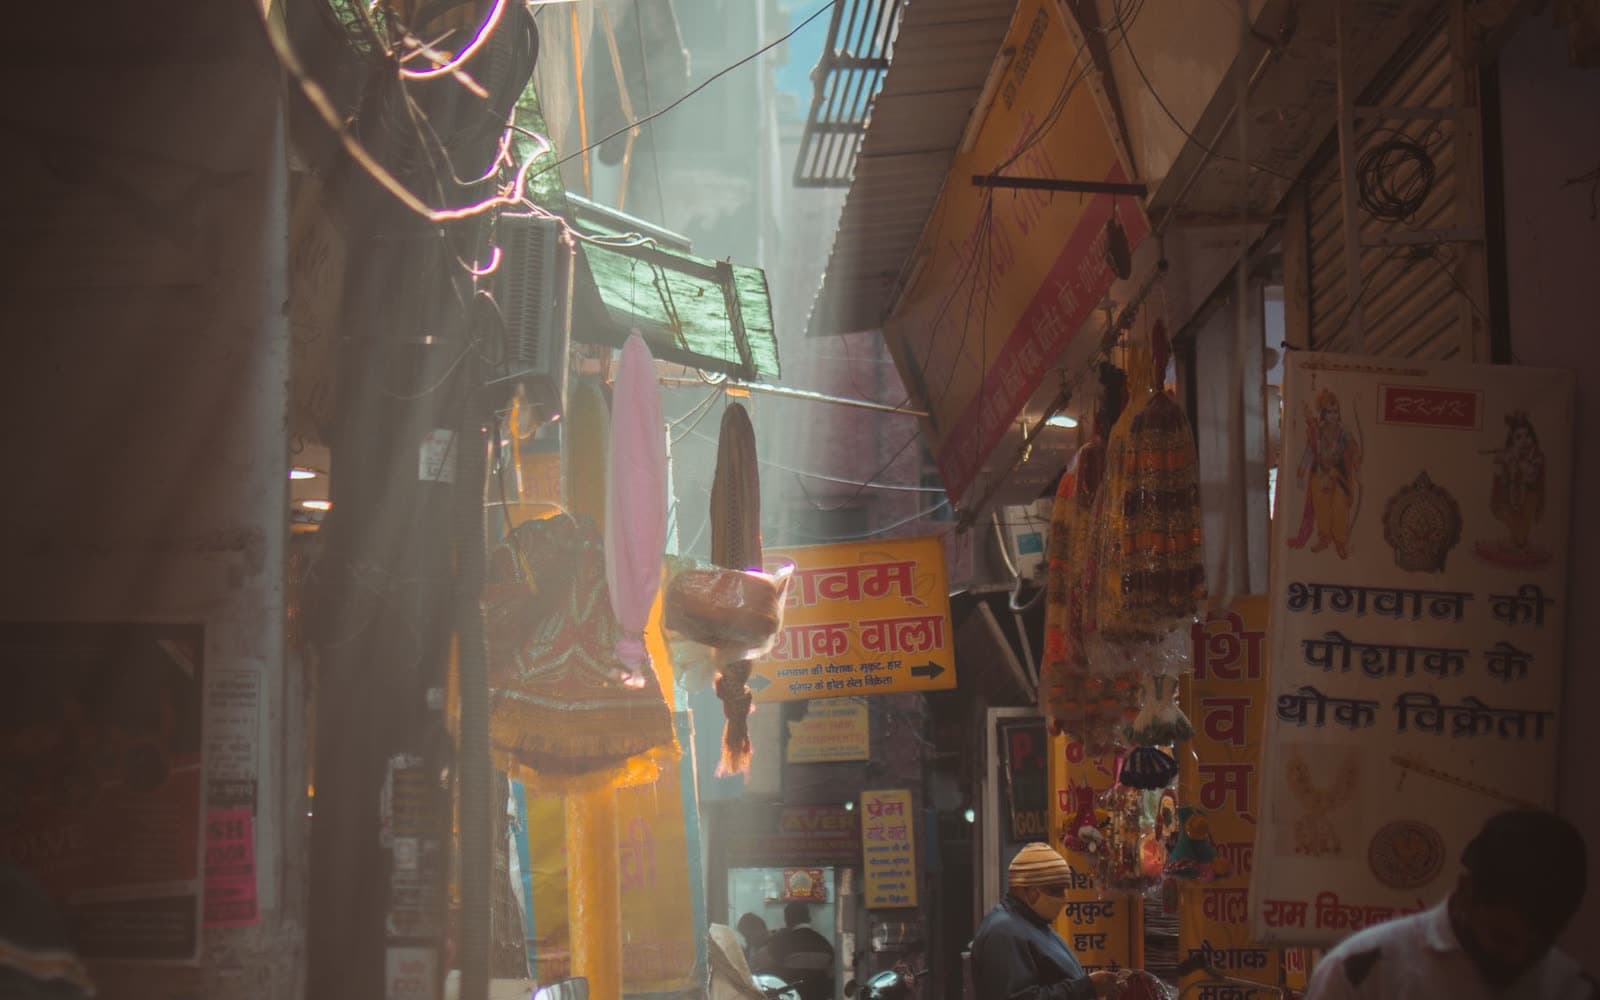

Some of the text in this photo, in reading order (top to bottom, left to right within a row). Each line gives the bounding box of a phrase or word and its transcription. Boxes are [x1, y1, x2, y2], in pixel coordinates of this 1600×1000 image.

[1286, 580, 1556, 628] भगवान की
[764, 616, 944, 661] शाक वाला
[887, 660, 903, 670] हार
[1301, 630, 1535, 682] पोशाक के
[1276, 686, 1556, 742] थोक विक्रेता
[866, 799, 904, 820] प्रेम
[1065, 901, 1115, 925] मुकुट
[1203, 888, 1248, 924] वाल
[1263, 899, 1308, 929] राम
[1073, 932, 1108, 952] हार
